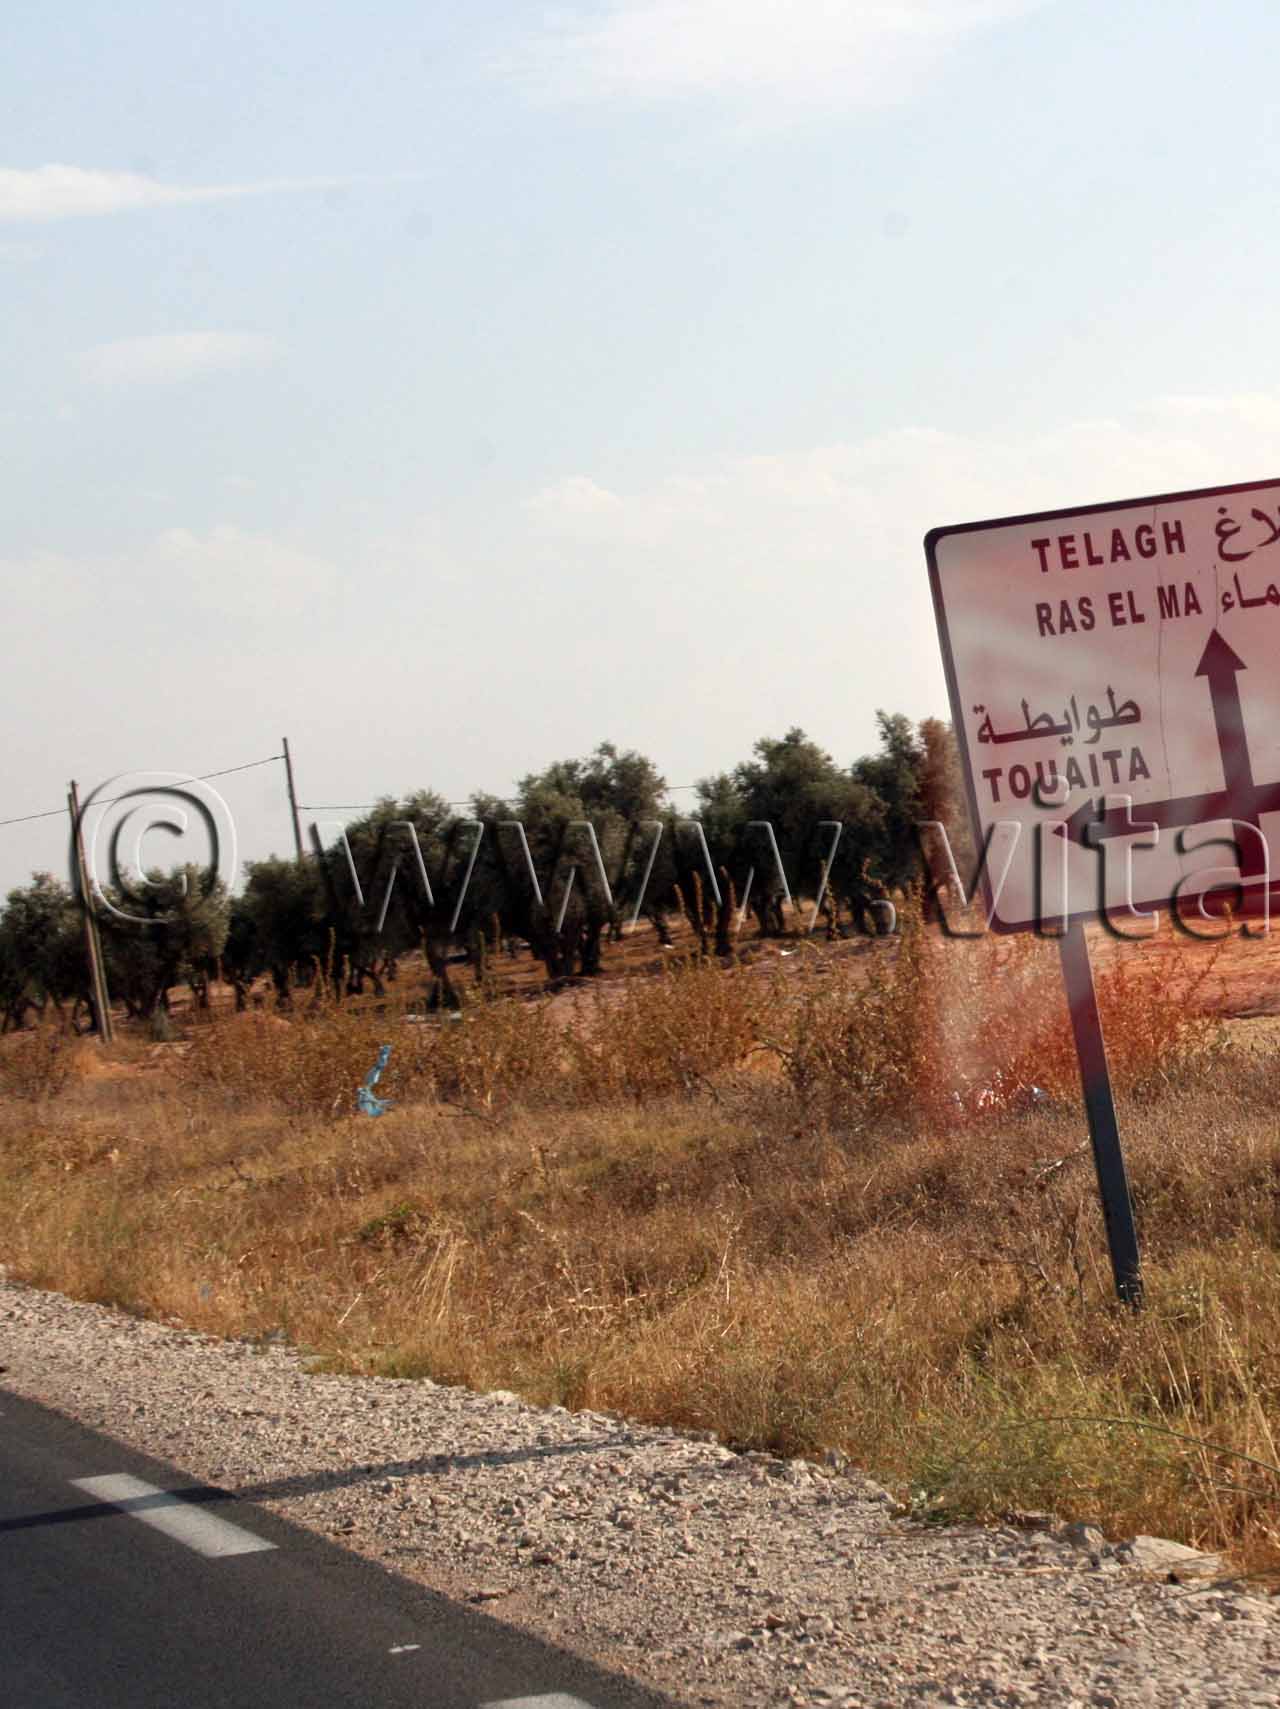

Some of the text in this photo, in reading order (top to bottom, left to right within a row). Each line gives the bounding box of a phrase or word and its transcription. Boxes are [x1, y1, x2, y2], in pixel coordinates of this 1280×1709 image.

[1031, 520, 1186, 572] TELAGH
[1035, 582, 1203, 637] RAS EL MA
[982, 746, 1151, 802] TOUAITA
